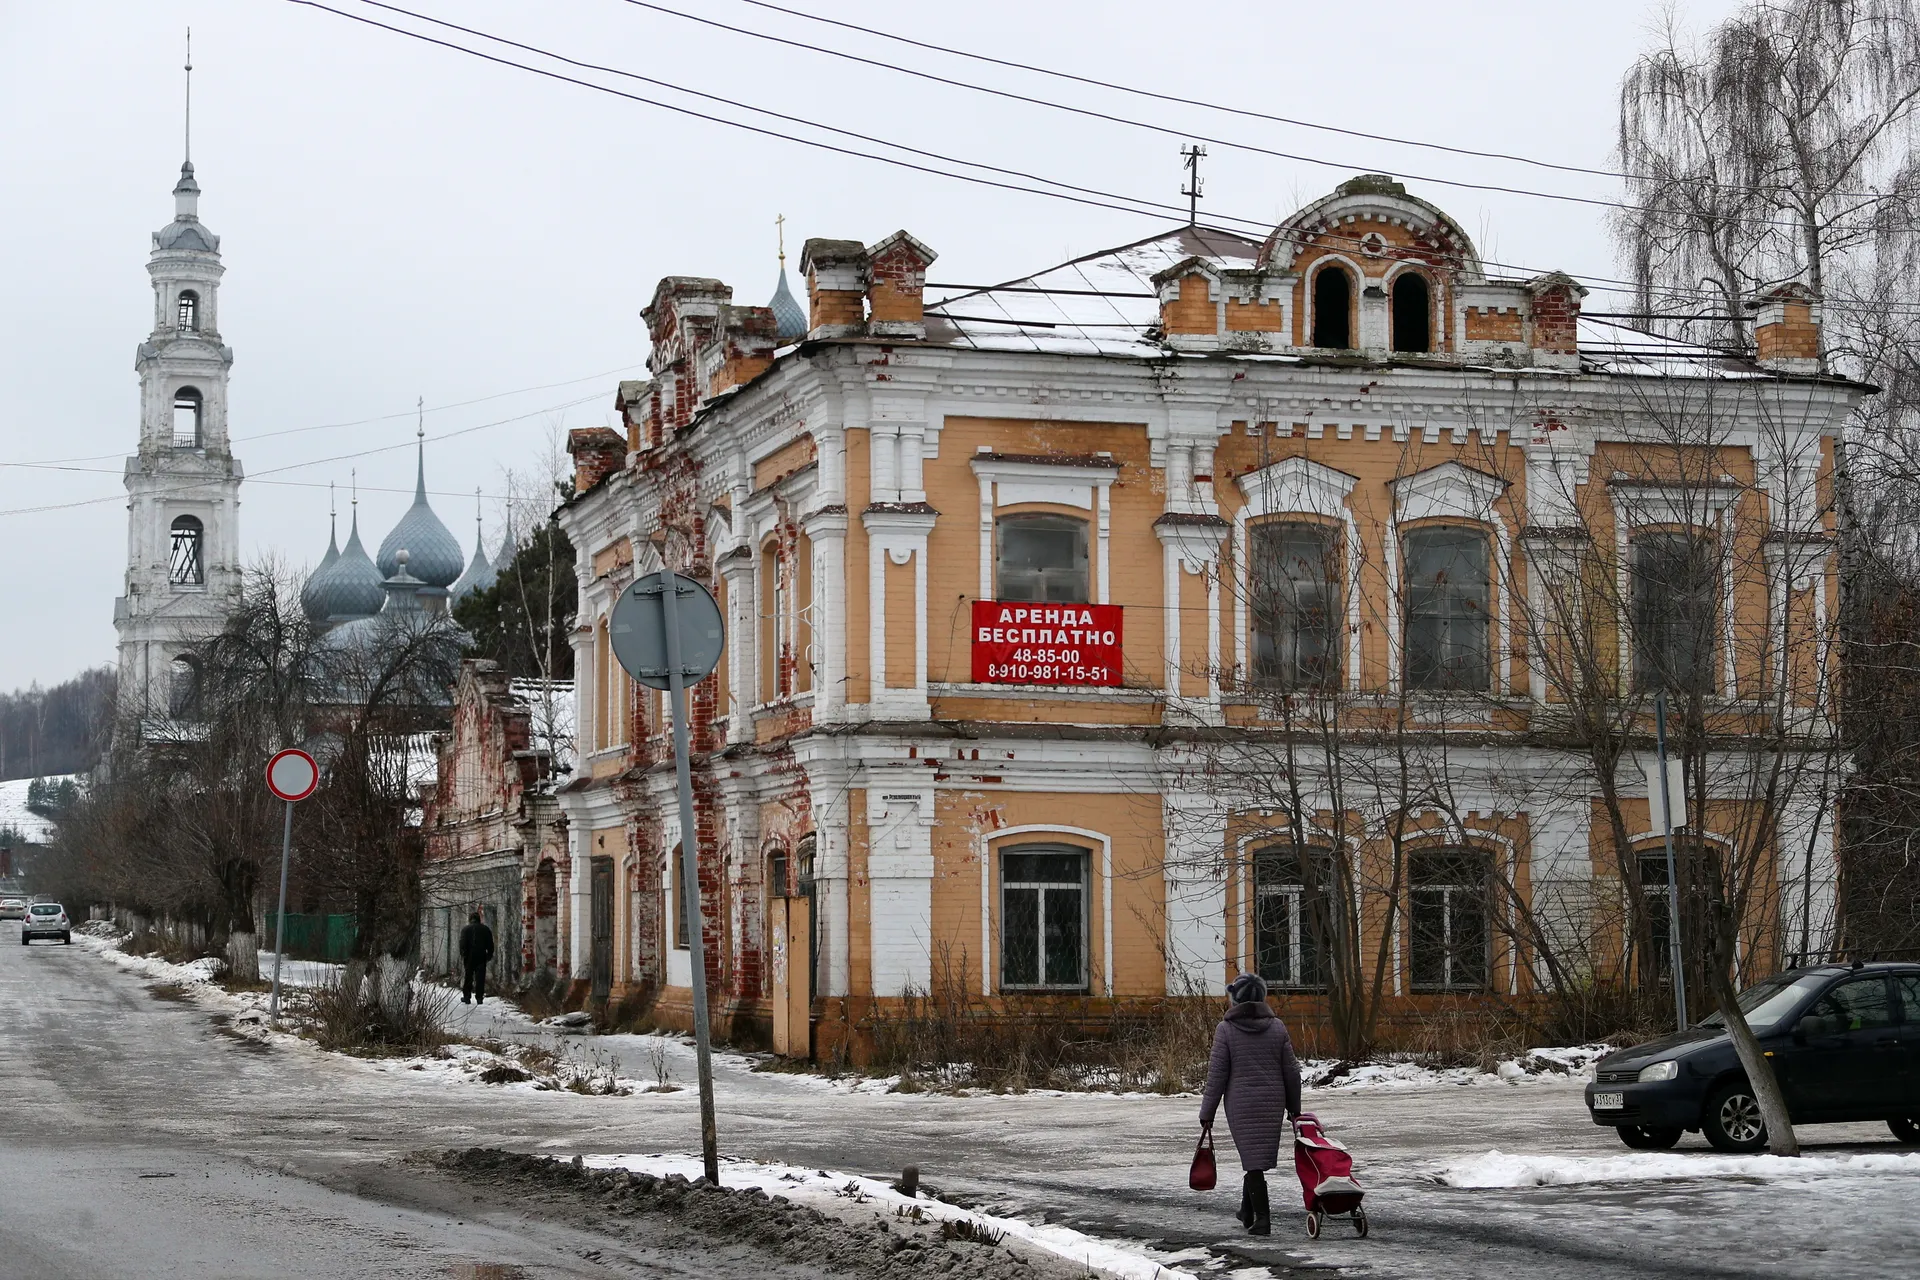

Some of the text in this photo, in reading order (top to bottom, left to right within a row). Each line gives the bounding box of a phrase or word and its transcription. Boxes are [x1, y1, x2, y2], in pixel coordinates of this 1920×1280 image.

[999, 608, 1093, 627] АРЕНДА
[978, 627, 1116, 645] БЕСПЛАТНО
[1013, 648, 1080, 663] 48-85-00
[988, 663, 1108, 681] 8-910-981-15-51
